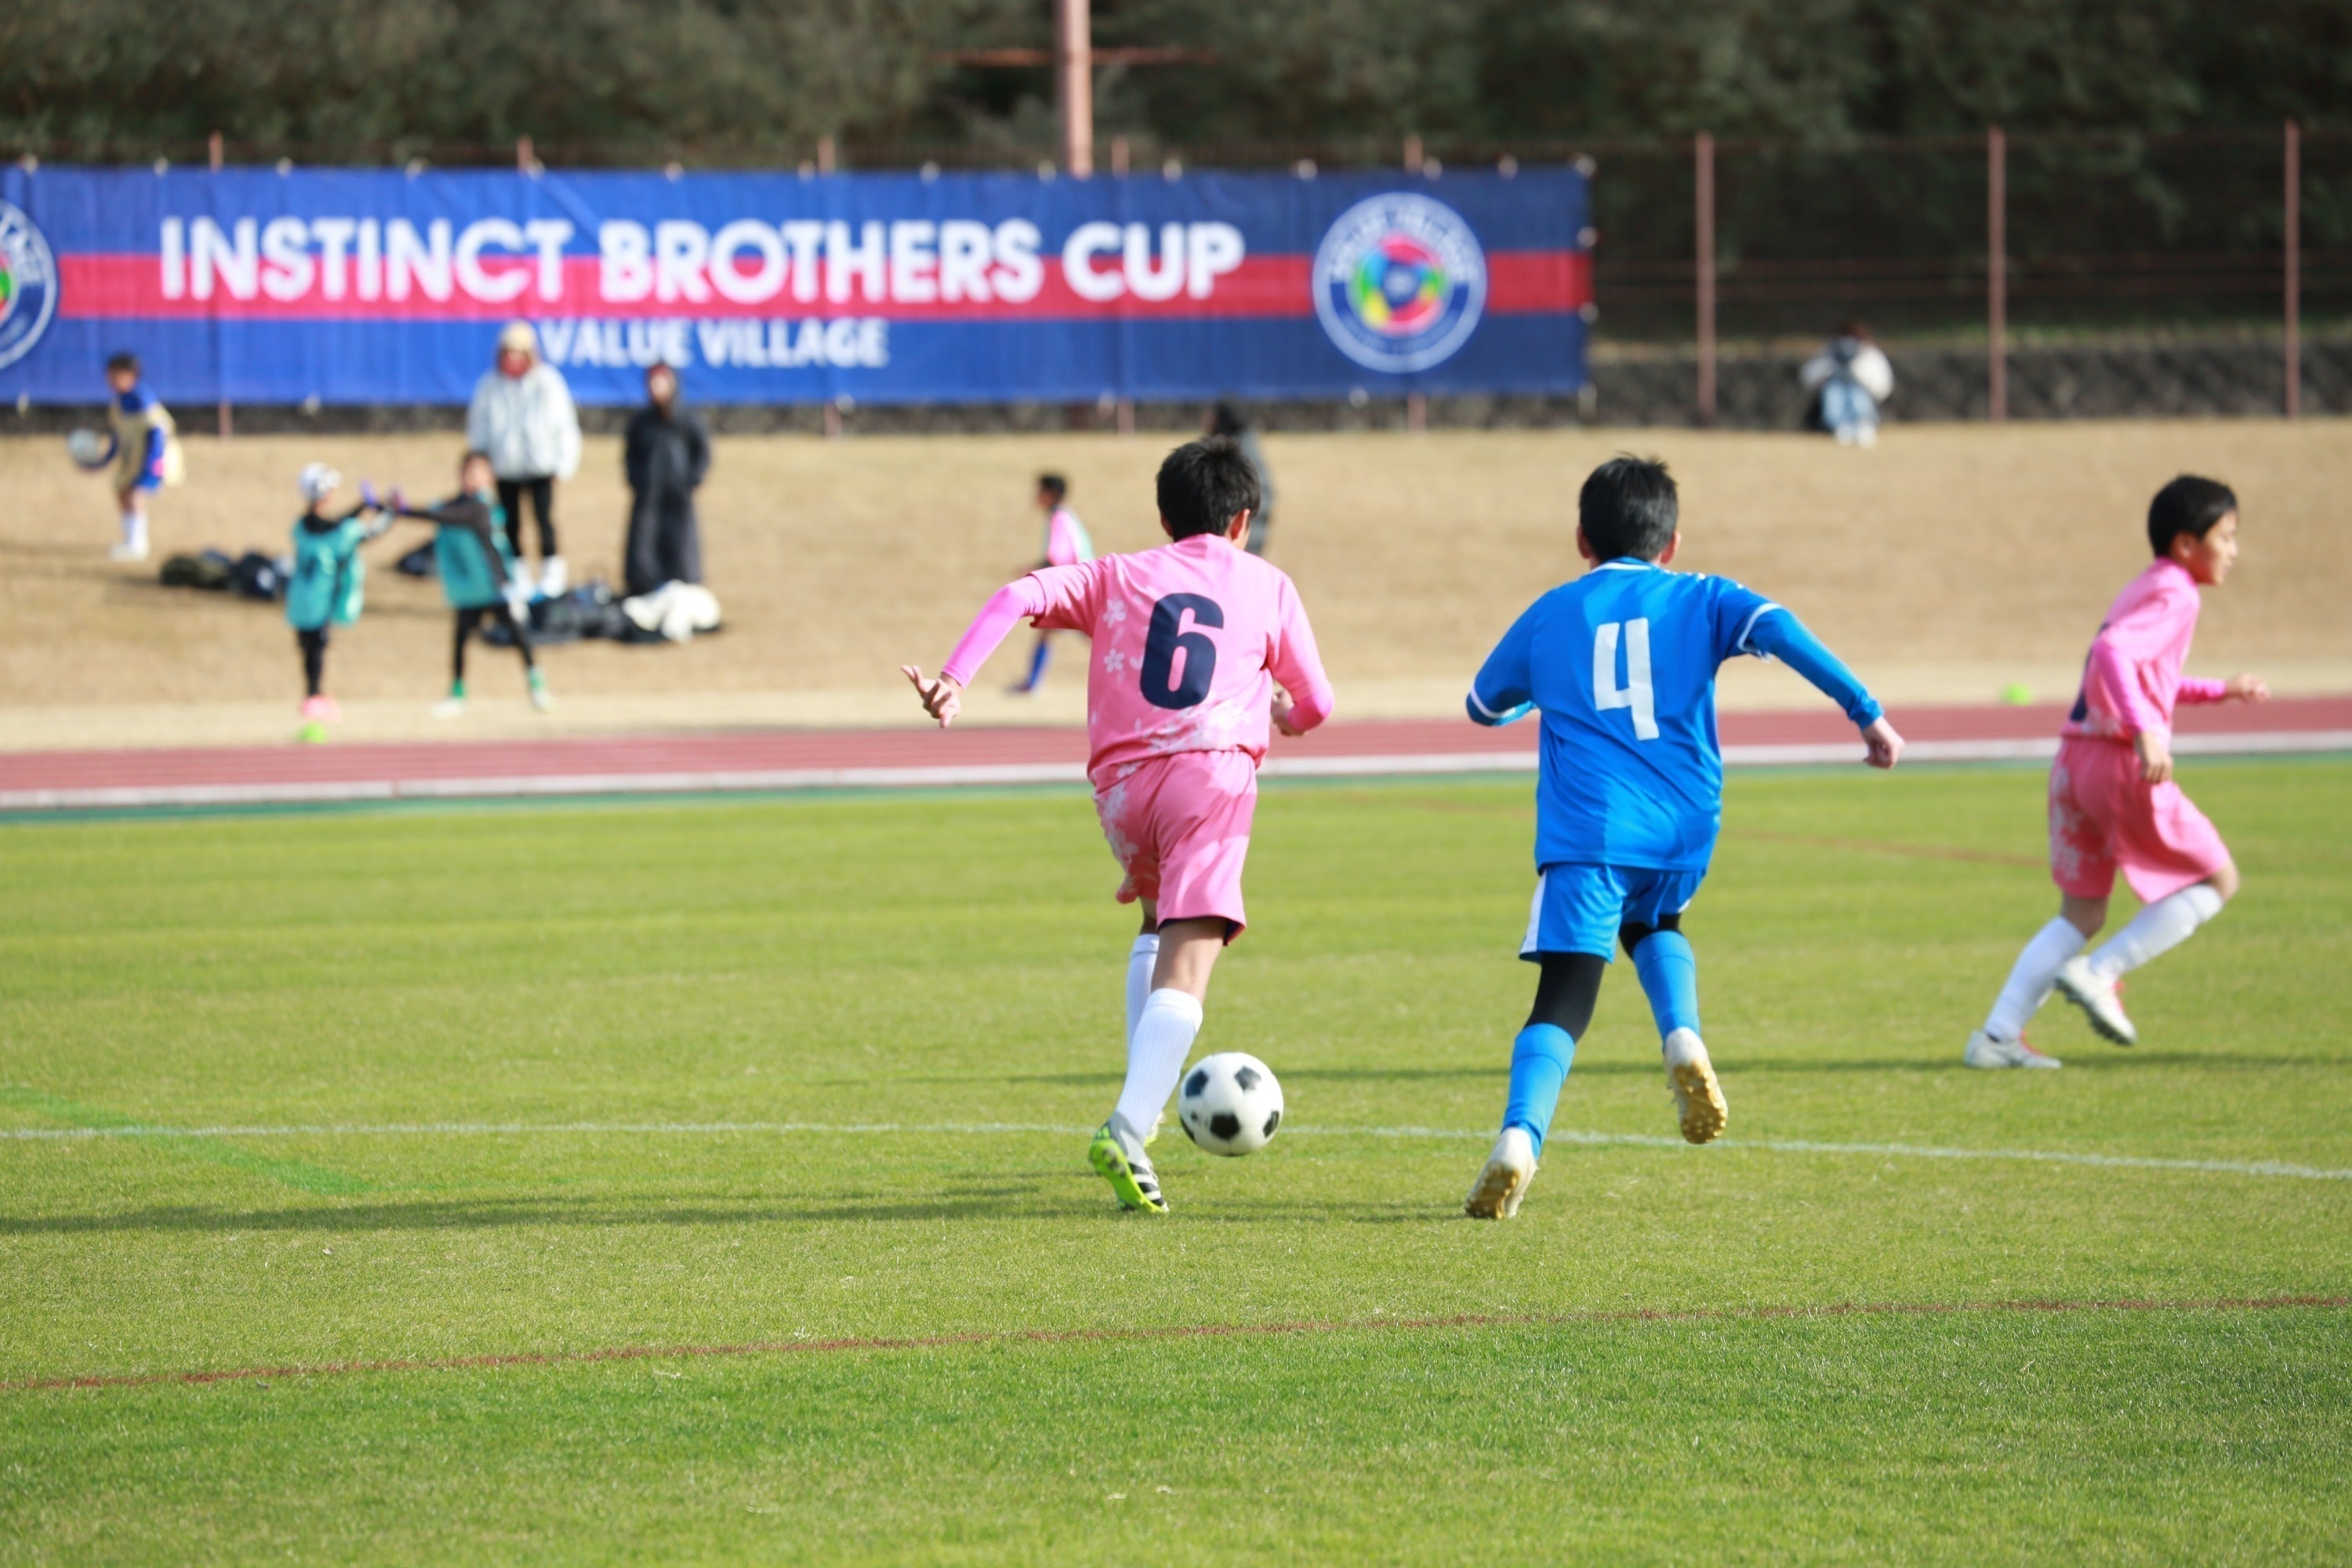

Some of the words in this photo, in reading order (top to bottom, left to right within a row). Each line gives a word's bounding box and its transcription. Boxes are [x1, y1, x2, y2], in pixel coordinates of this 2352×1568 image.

[160, 216, 574, 303] INSTINCT
[599, 219, 1044, 303] BROTHERS
[1062, 220, 1245, 302] CUP
[537, 318, 694, 368] VALUE
[696, 318, 887, 368] VILLAGE
[1140, 592, 1224, 710] 6
[1593, 618, 1659, 740] 4
